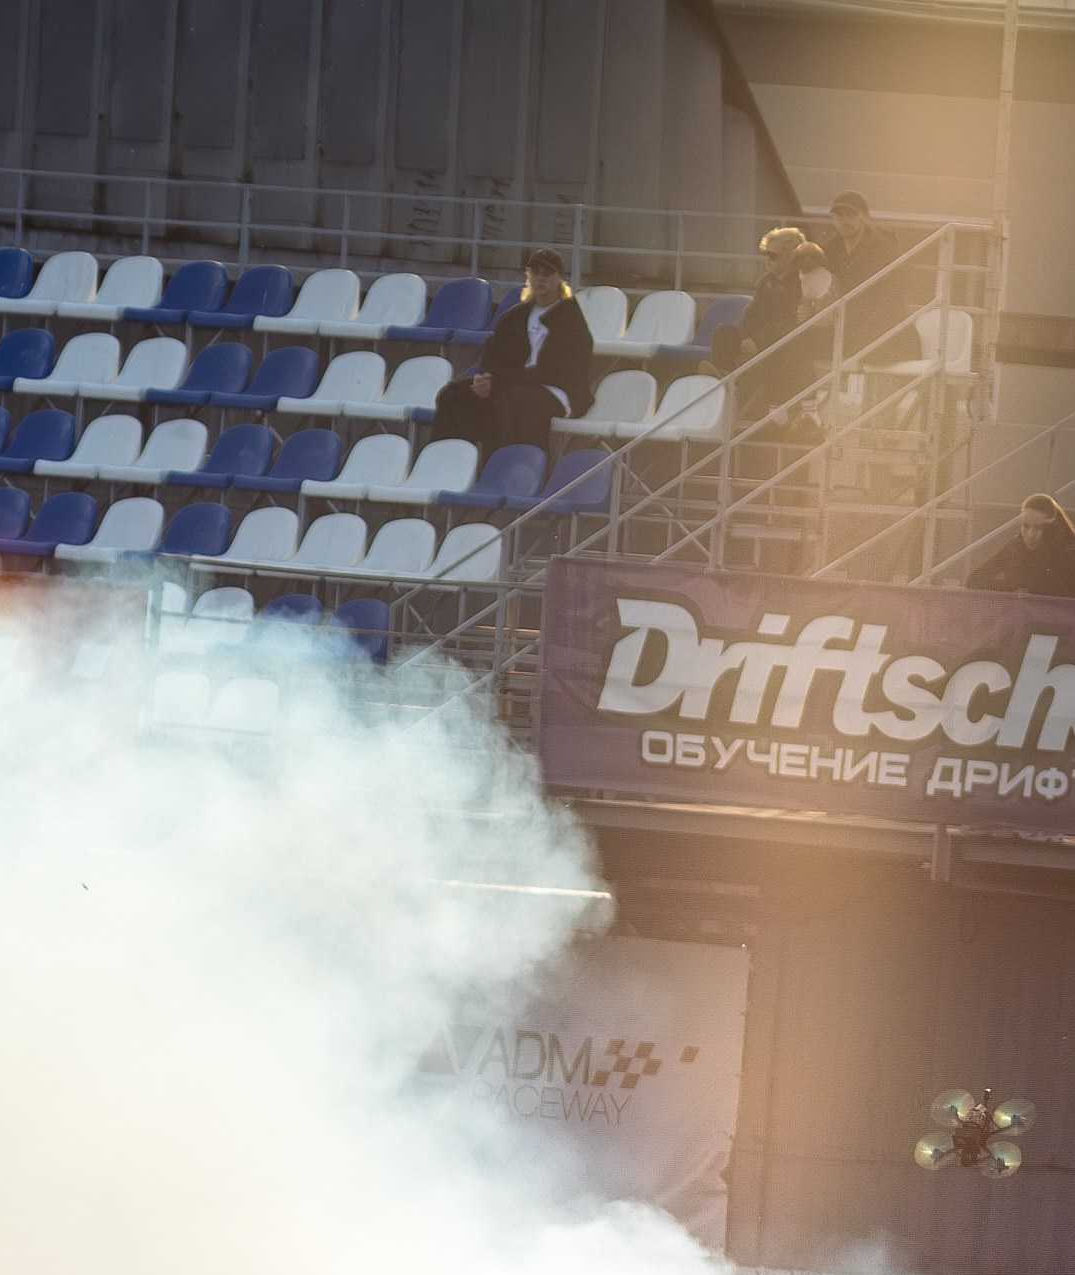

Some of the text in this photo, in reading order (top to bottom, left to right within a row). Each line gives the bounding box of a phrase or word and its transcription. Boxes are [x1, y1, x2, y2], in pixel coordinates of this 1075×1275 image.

[641, 730, 1075, 800] ОБУЧЕНИЕ ДРИФ
[477, 1028, 592, 1085] ADM
